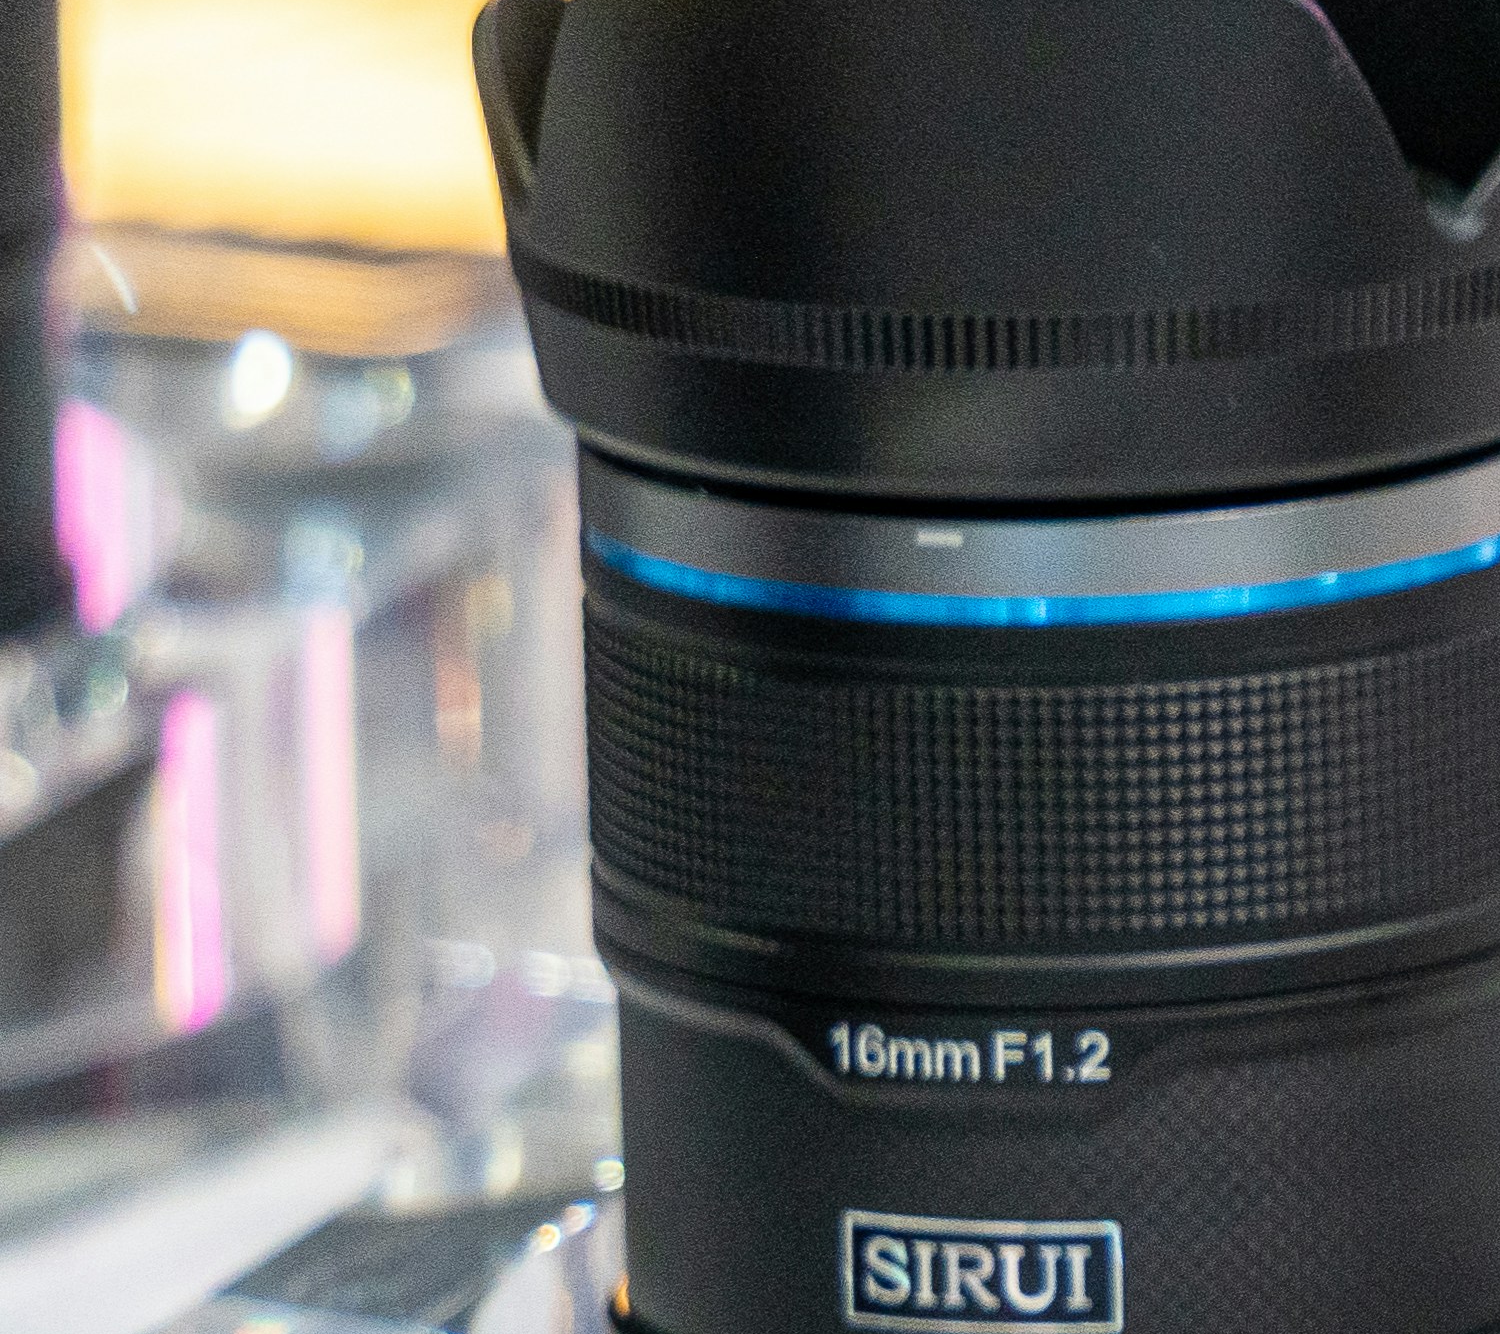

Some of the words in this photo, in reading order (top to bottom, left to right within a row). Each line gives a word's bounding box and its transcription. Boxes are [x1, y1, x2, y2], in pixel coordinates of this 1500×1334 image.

[828, 1022, 980, 1082] 16mm
[992, 1028, 1112, 1083] F1.2
[861, 1233, 1094, 1315] SIRUI
